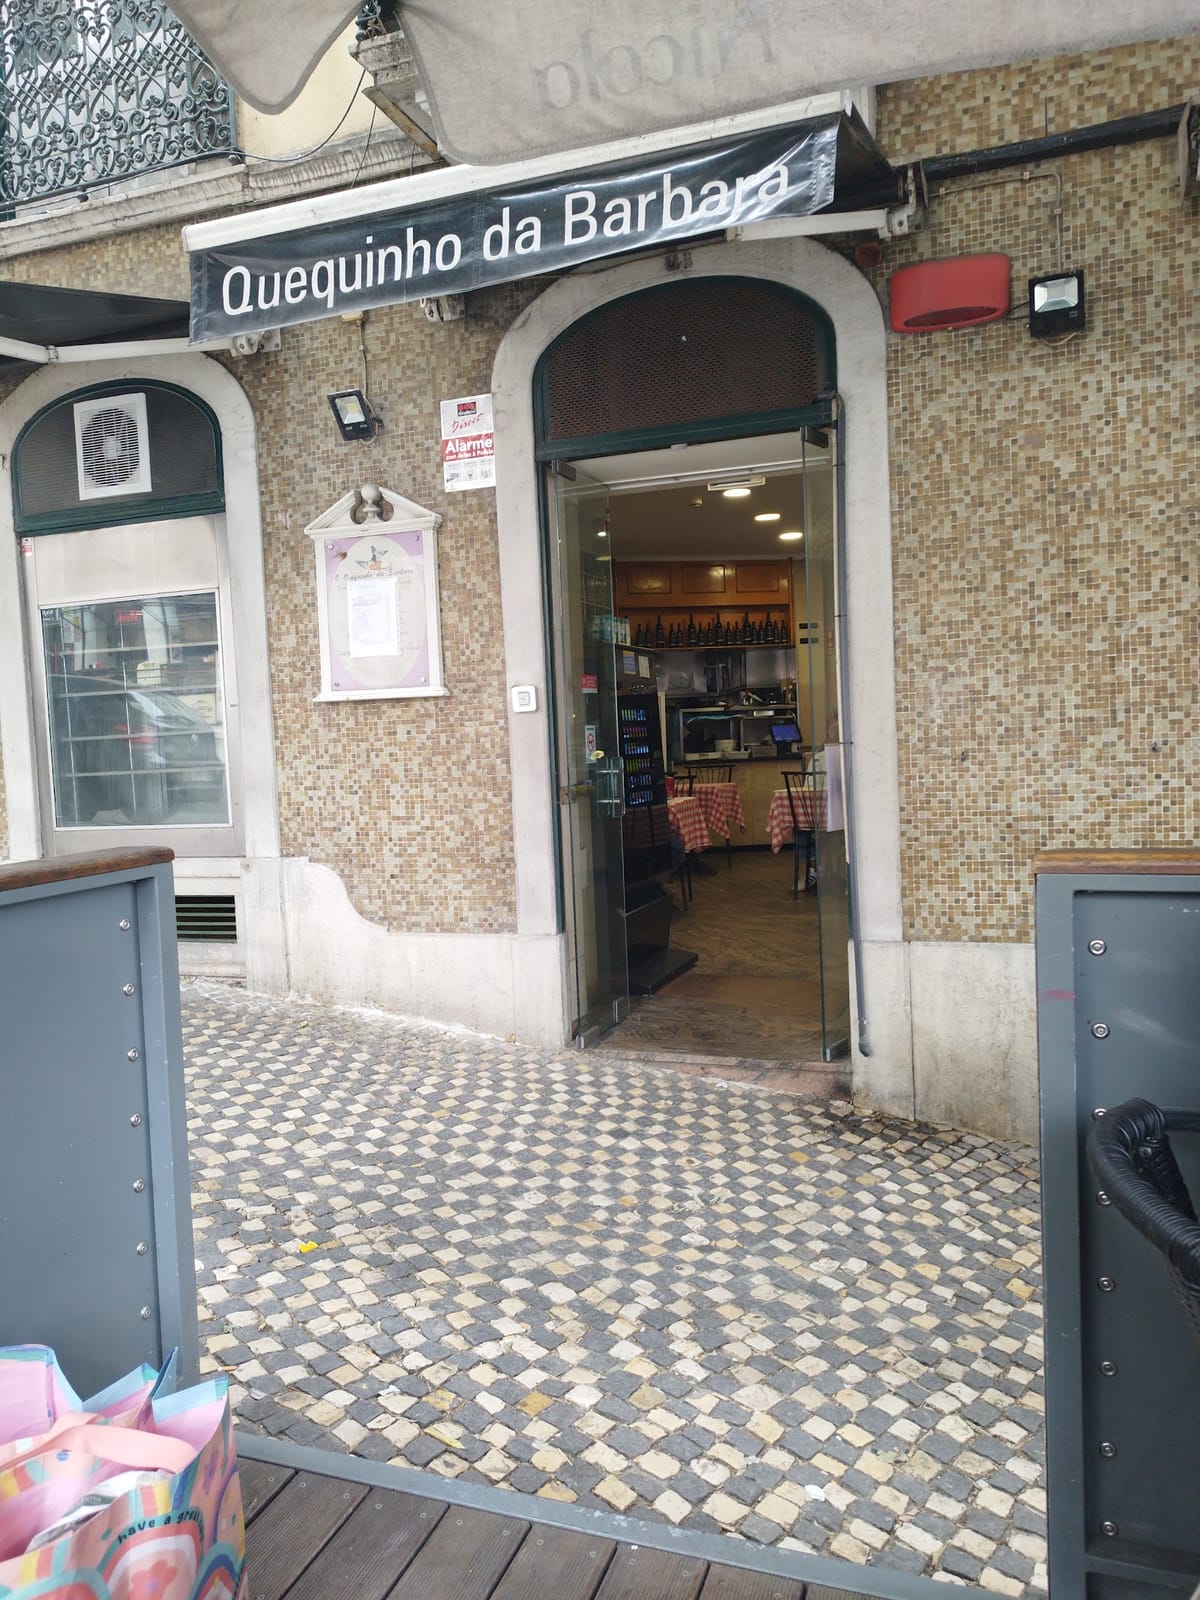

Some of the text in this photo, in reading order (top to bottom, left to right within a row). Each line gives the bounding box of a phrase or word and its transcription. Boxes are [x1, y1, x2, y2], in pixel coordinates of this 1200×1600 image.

[221, 163, 789, 317] Quequinho da Barbara
[446, 438, 493, 454] Alarme
[118, 1520, 156, 1544] have
[163, 1515, 172, 1525] a
